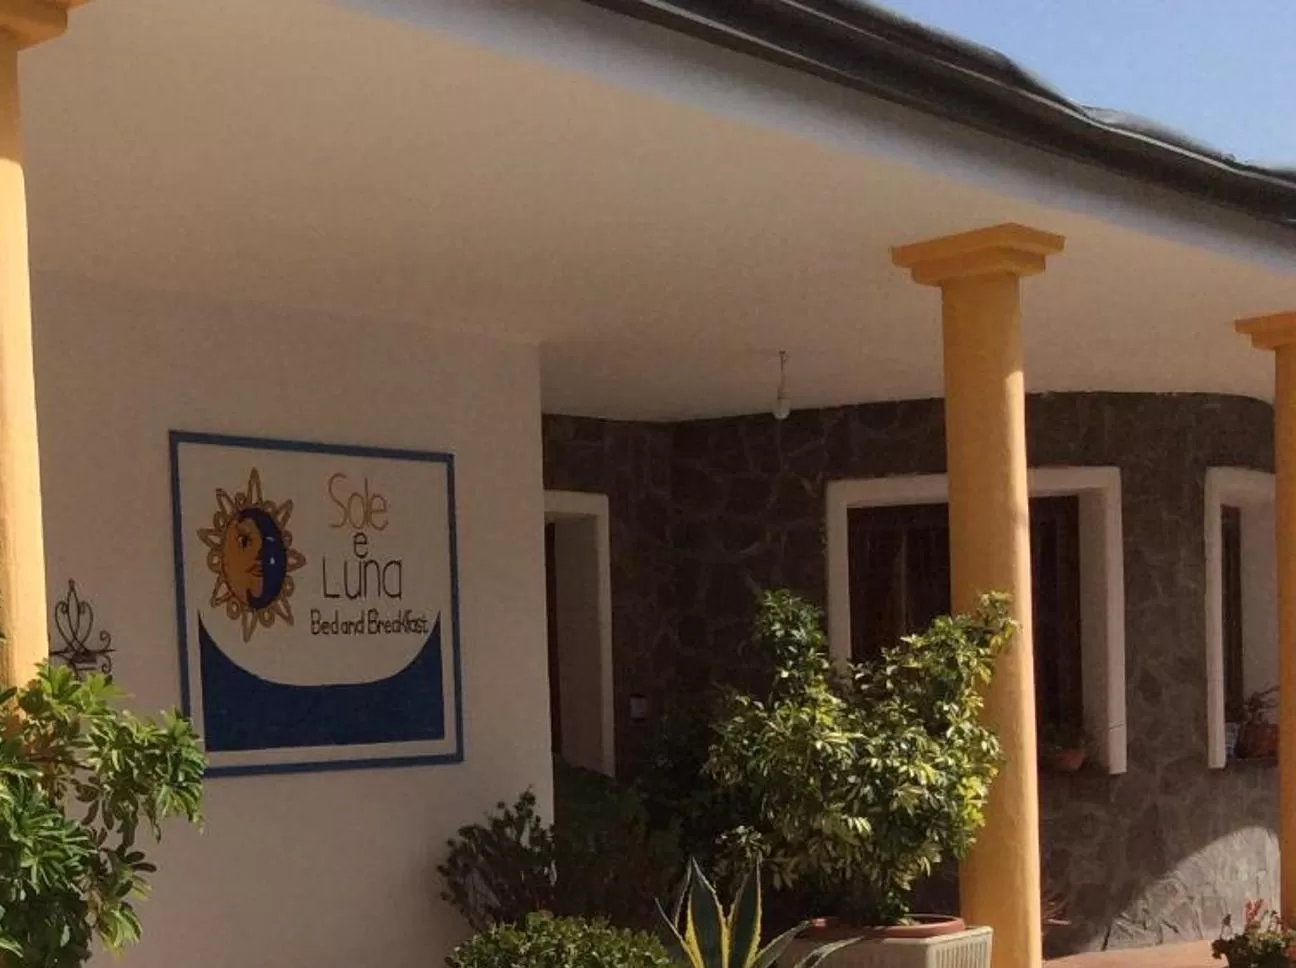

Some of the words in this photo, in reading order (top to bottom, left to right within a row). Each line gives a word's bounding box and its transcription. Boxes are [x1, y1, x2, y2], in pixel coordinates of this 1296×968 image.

[328, 473, 389, 530] Sole
[354, 532, 368, 558] e
[322, 557, 402, 600] Luna
[310, 608, 339, 635] Bed
[340, 611, 365, 635] and
[367, 608, 428, 634] Breakfast
